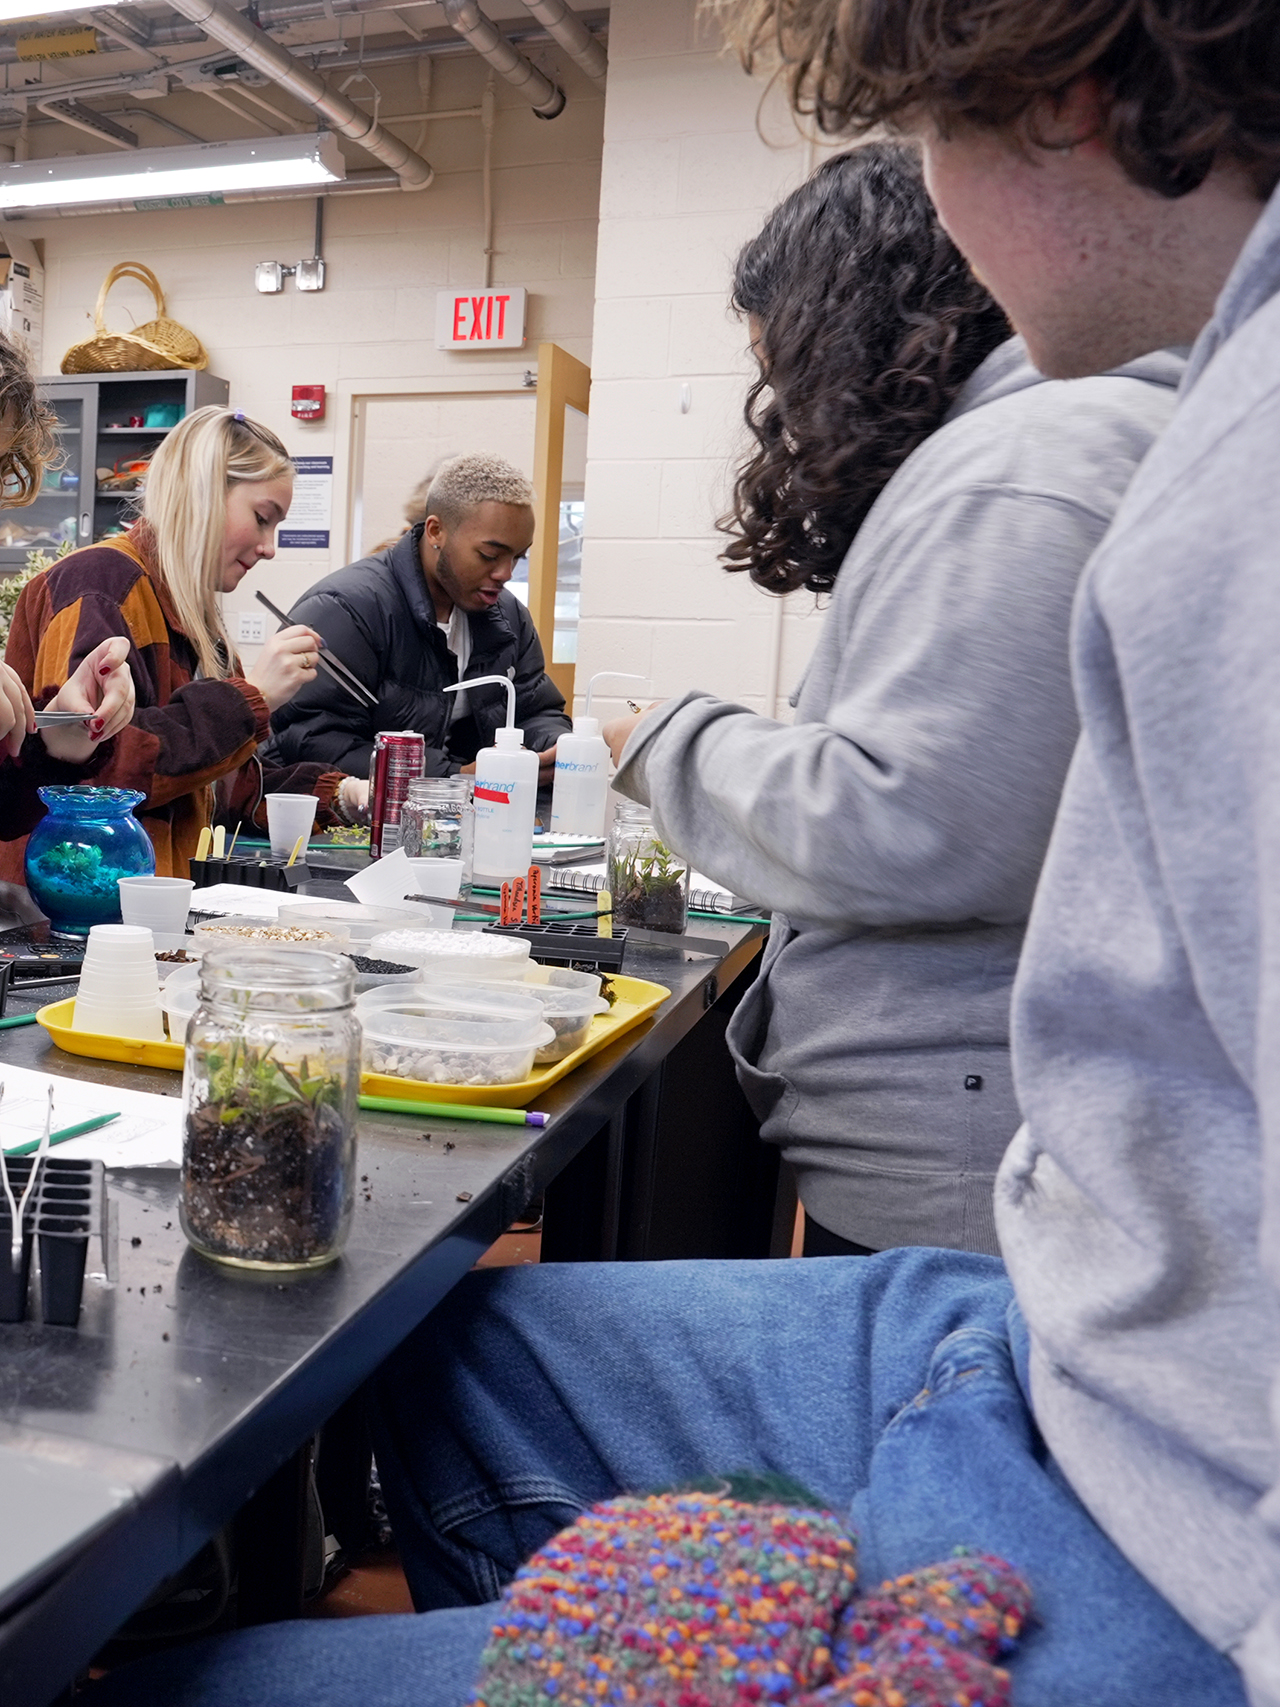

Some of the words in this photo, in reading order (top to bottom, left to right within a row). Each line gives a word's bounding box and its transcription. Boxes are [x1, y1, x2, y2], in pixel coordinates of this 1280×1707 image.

[34, 29, 56, 39] WATER
[58, 26, 84, 36] RETURN
[170, 197, 190, 208] COLD
[452, 295, 511, 341] EXIT
